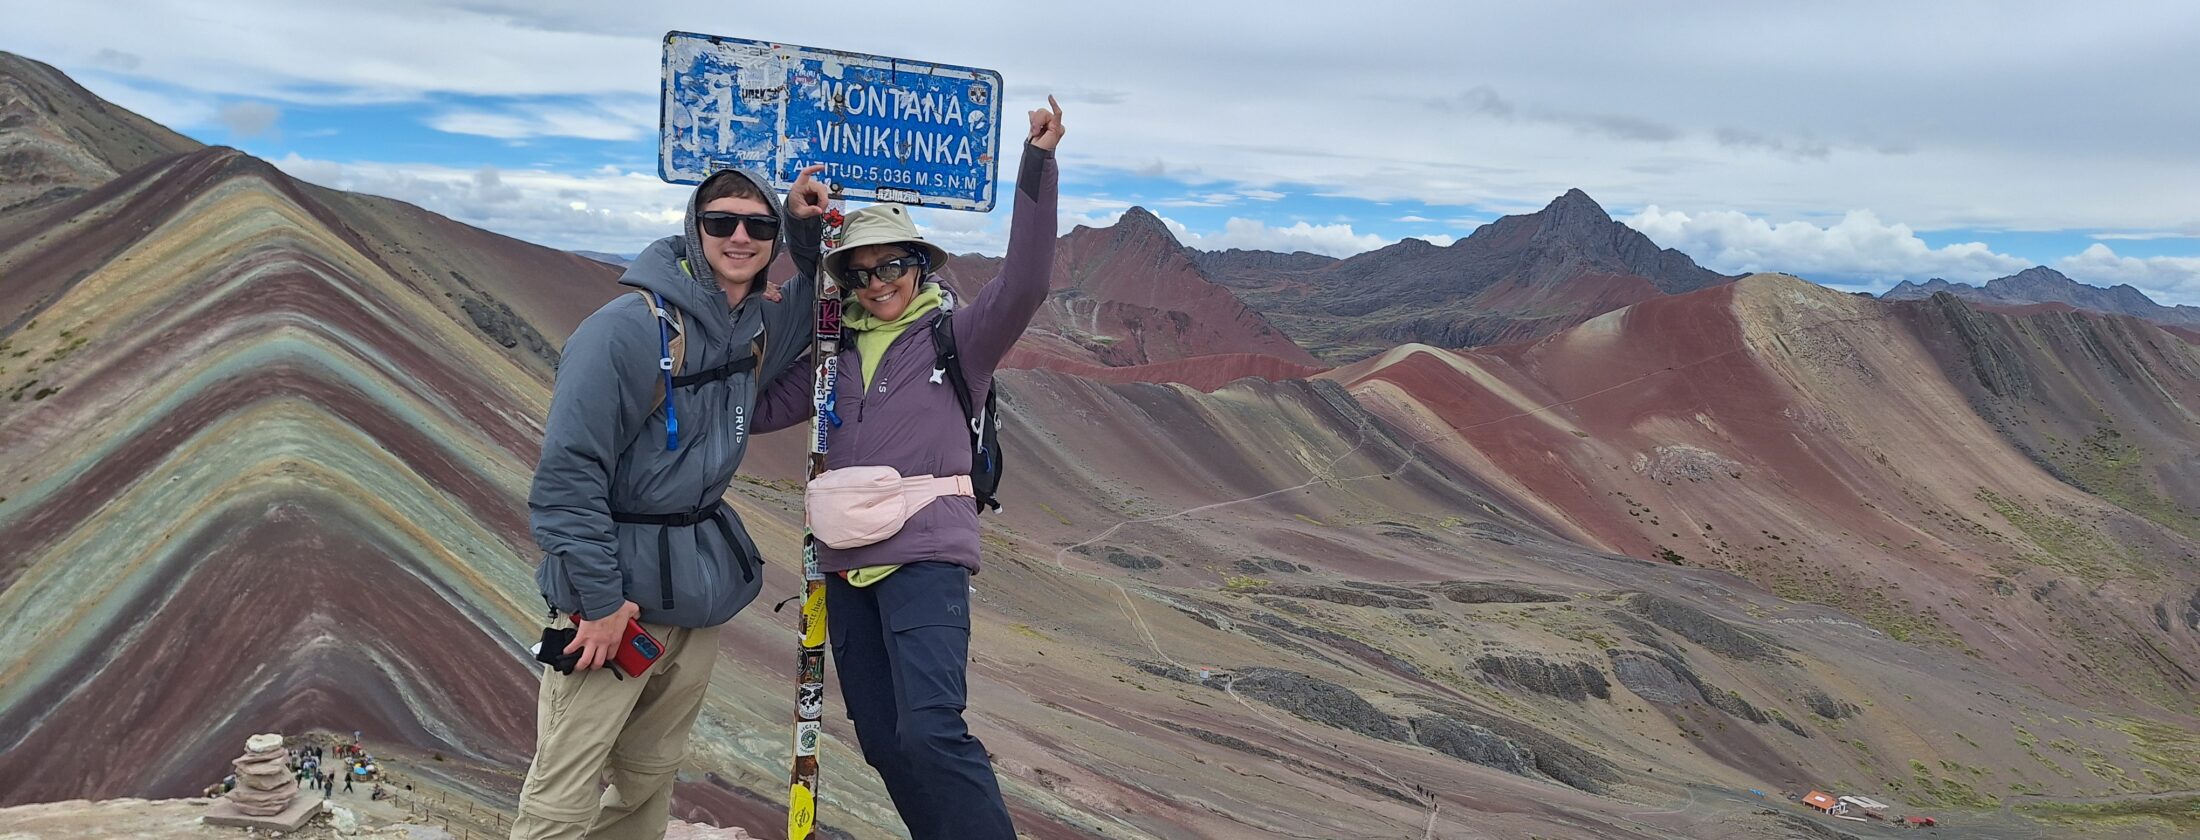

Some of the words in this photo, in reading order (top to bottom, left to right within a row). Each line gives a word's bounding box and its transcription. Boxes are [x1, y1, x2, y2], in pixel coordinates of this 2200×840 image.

[820, 80, 963, 127] MONTAÑA
[816, 119, 973, 167] VINIKUNKA
[735, 406, 744, 443] ORVIS
[818, 403, 826, 452] SUNSHINE
